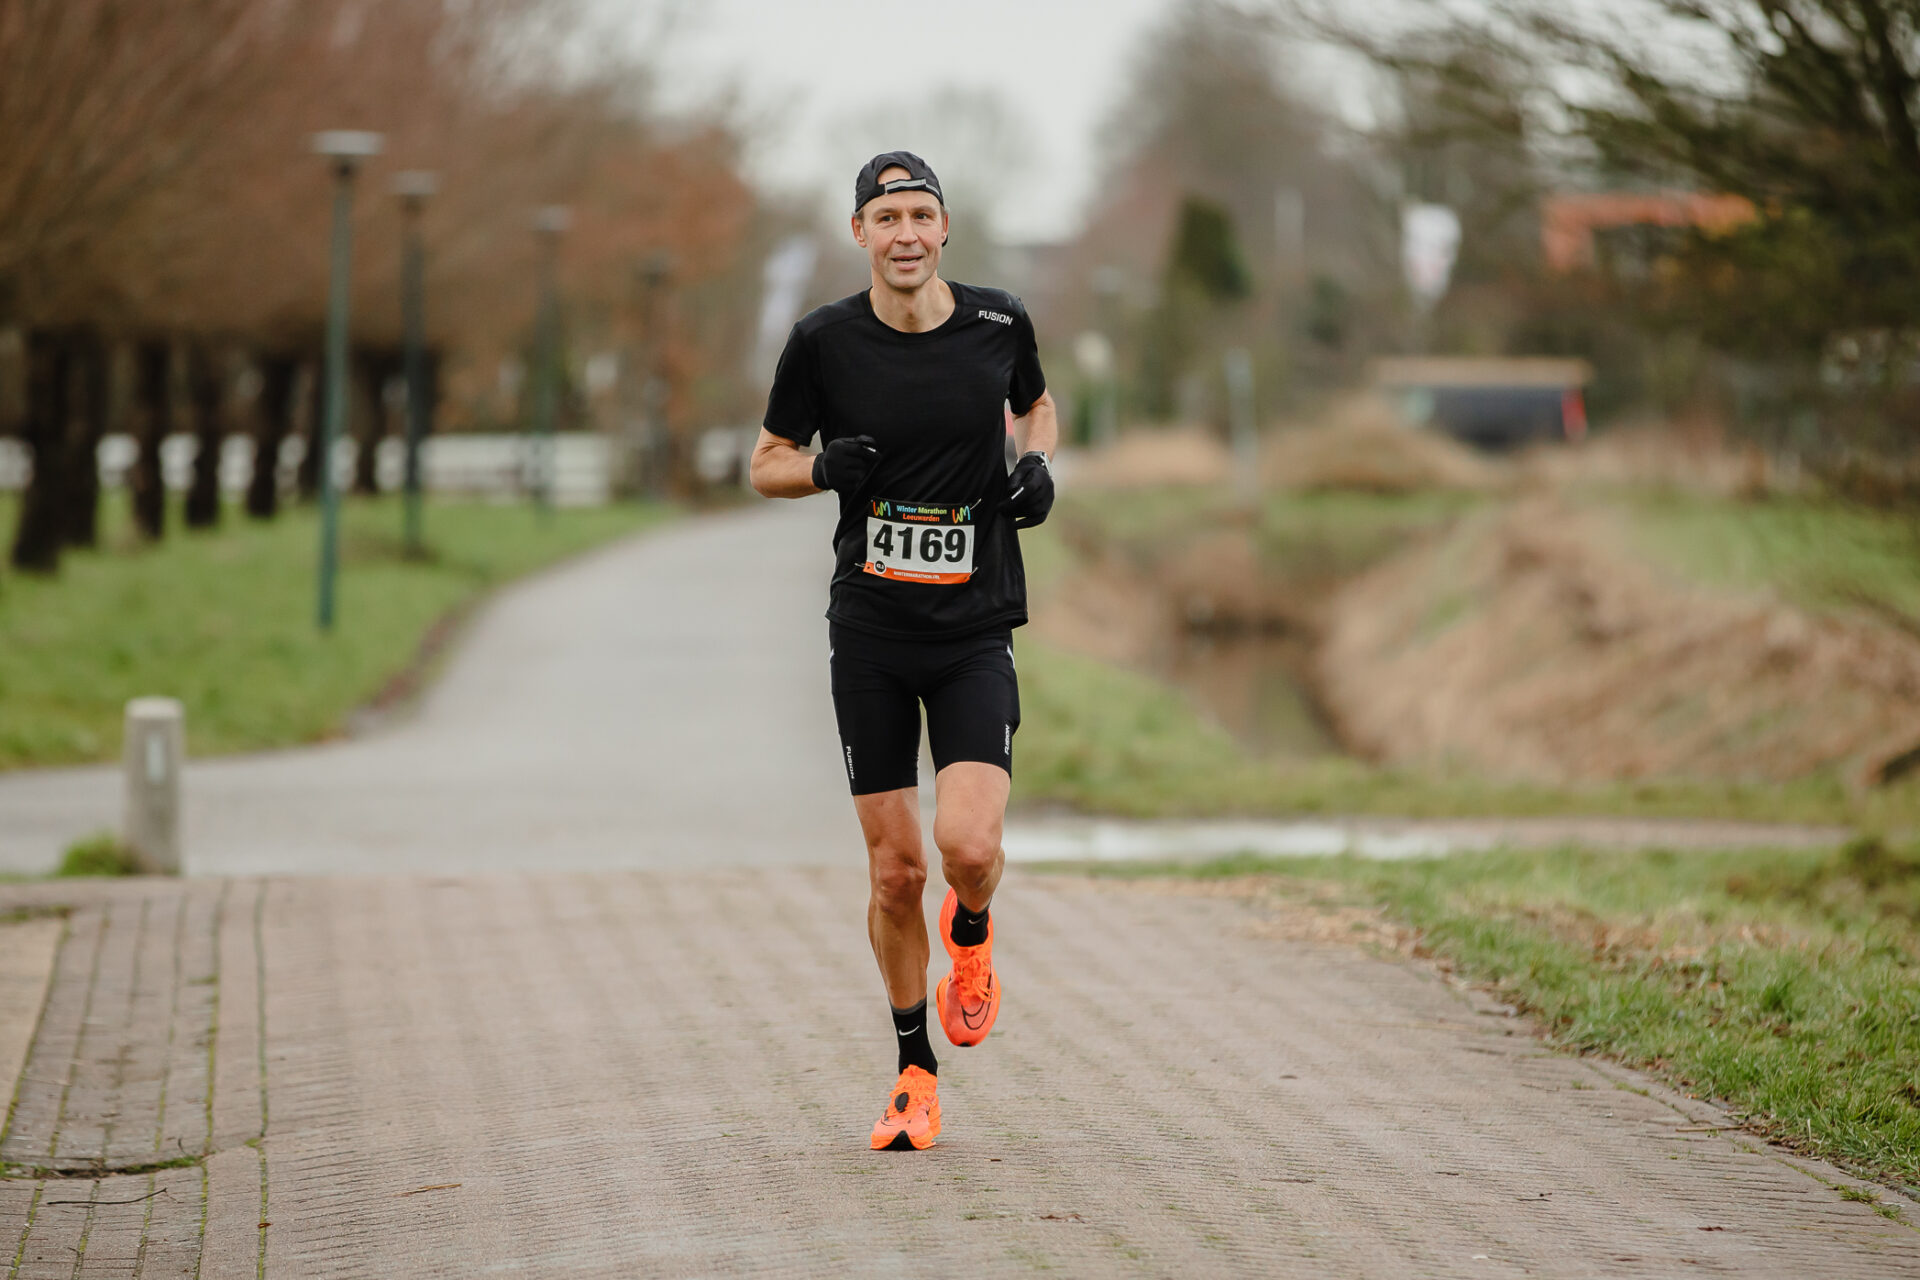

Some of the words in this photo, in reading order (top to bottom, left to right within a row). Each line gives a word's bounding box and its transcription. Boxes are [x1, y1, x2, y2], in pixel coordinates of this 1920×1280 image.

[978, 310, 1013, 326] FUSION
[896, 505, 917, 514] Winter
[917, 507, 948, 515] Marathon
[902, 513, 940, 522] Leeuwarden
[873, 523, 966, 563] 4169
[845, 745, 855, 779] FUSION
